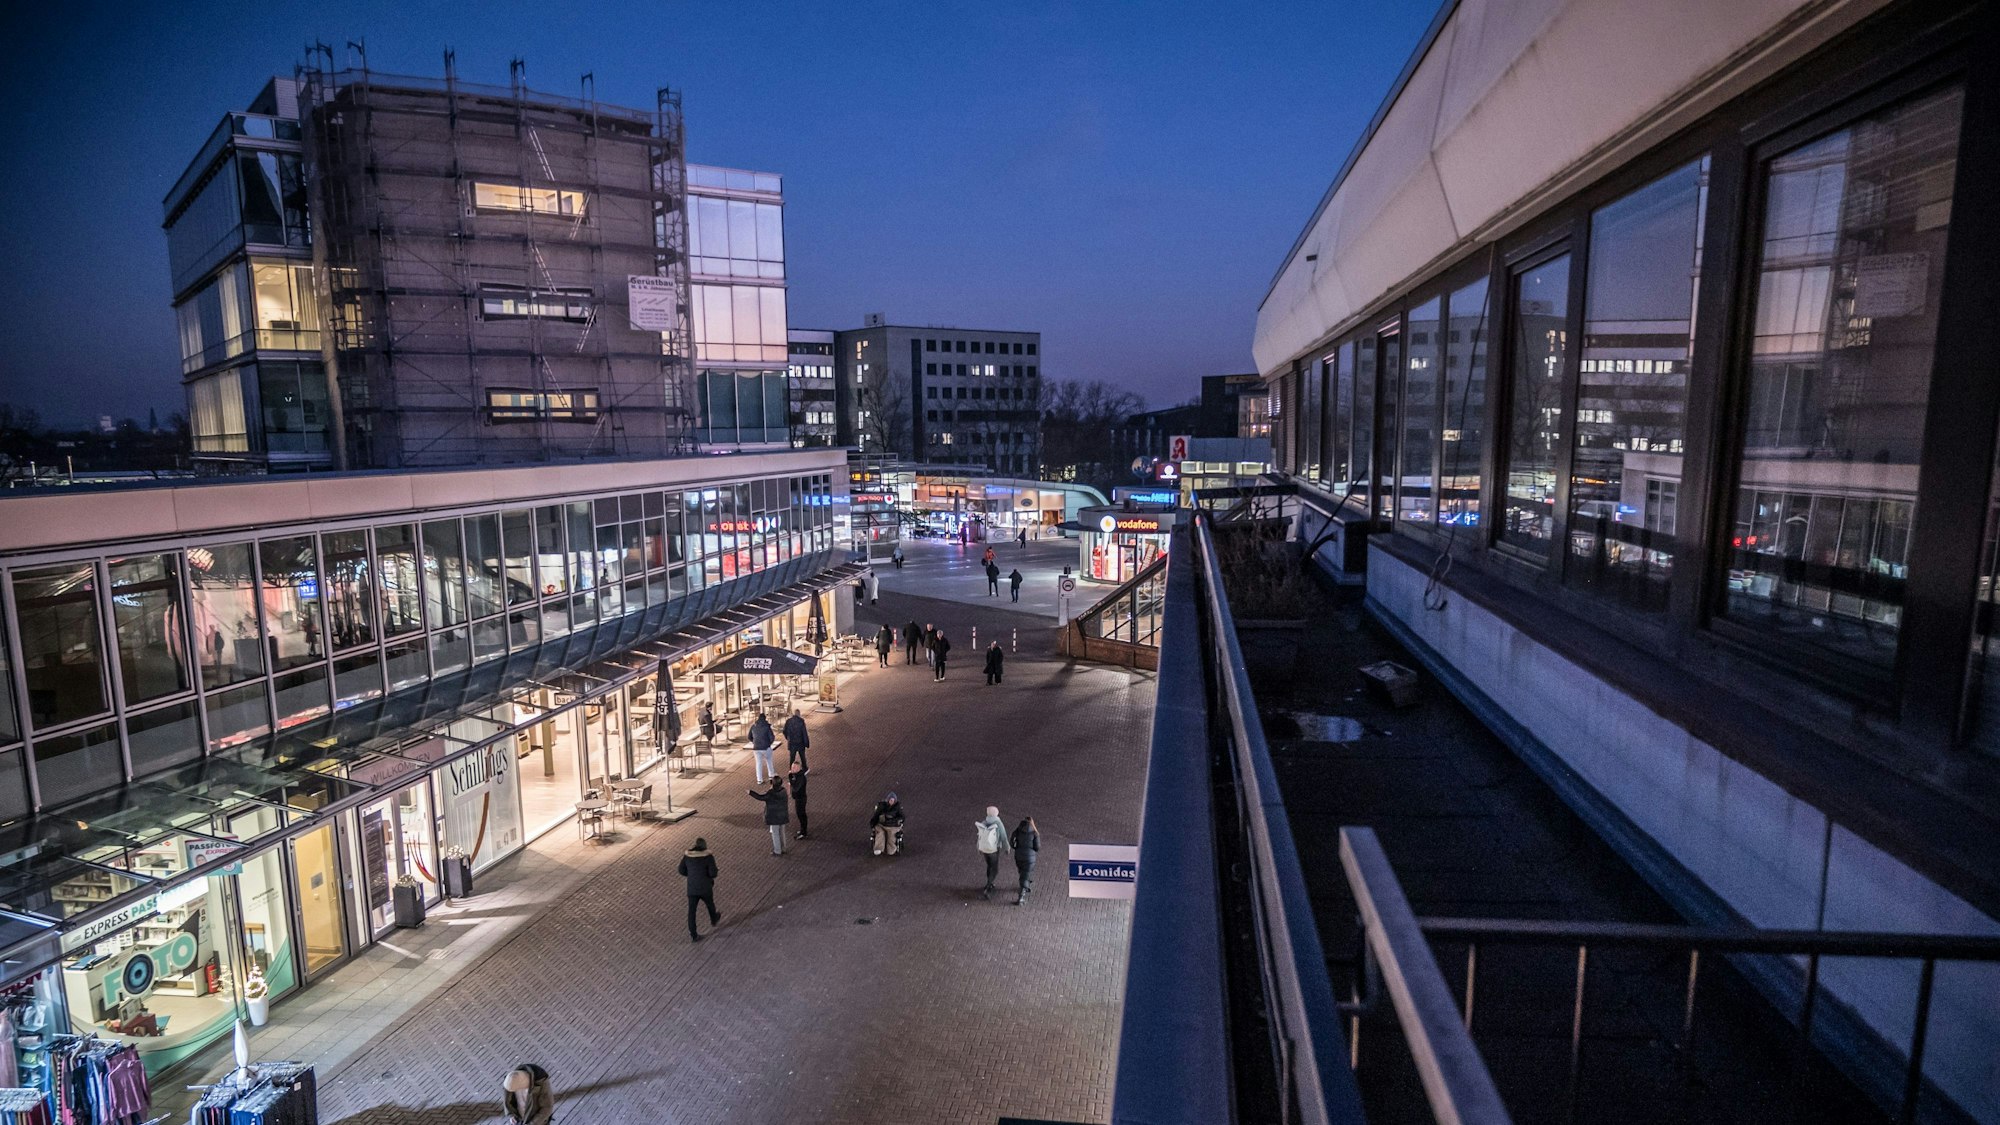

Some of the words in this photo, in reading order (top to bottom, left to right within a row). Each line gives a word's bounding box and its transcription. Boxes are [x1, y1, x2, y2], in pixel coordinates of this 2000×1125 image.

[631, 277, 673, 286] Gerüstbau
[1117, 520, 1158, 530] vodafone
[370, 752, 431, 784] WILLKOMEN
[451, 747, 508, 796] Schillings
[1078, 865, 1136, 878] Leonidas
[84, 910, 129, 940] EXPRESS
[103, 931, 197, 1009] FOTO
